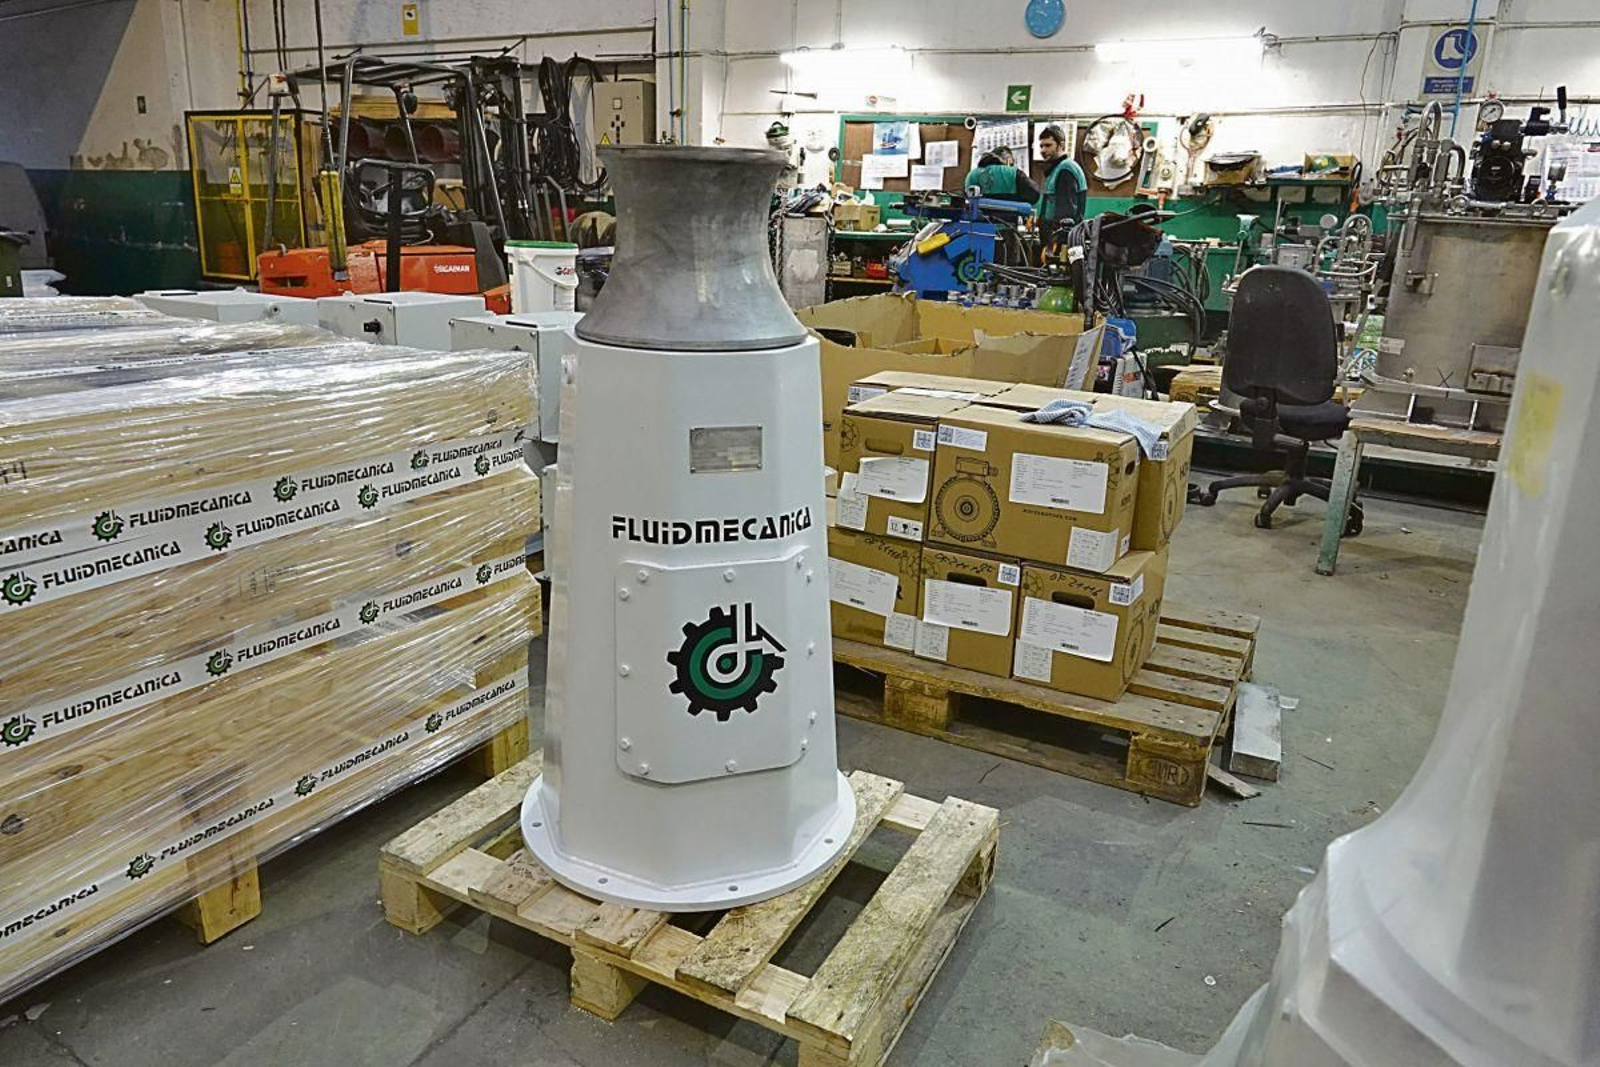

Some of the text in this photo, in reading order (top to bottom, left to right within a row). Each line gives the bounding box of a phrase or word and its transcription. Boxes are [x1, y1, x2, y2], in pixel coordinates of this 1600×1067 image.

[42, 541, 182, 589] FLUIDMECANICA
[236, 499, 340, 538] FLUIDMECANICA
[381, 466, 461, 498] FLUIDMECANICA
[129, 491, 252, 528] FLUIDMECANICA
[301, 461, 394, 492] FLUIDMECANICA
[432, 440, 502, 464] FLUIDMECANICA
[612, 506, 812, 545] FLUIDMECANICA
[42, 671, 182, 728] FLUIDMECANICA
[237, 618, 341, 662] FLUIDMECANICA
[383, 577, 462, 613] FLUIDMECANICA
[0, 679, 516, 940] MECANICA FLUIDMECANICA FLUIDMECANICA FLUIDMECANICA
